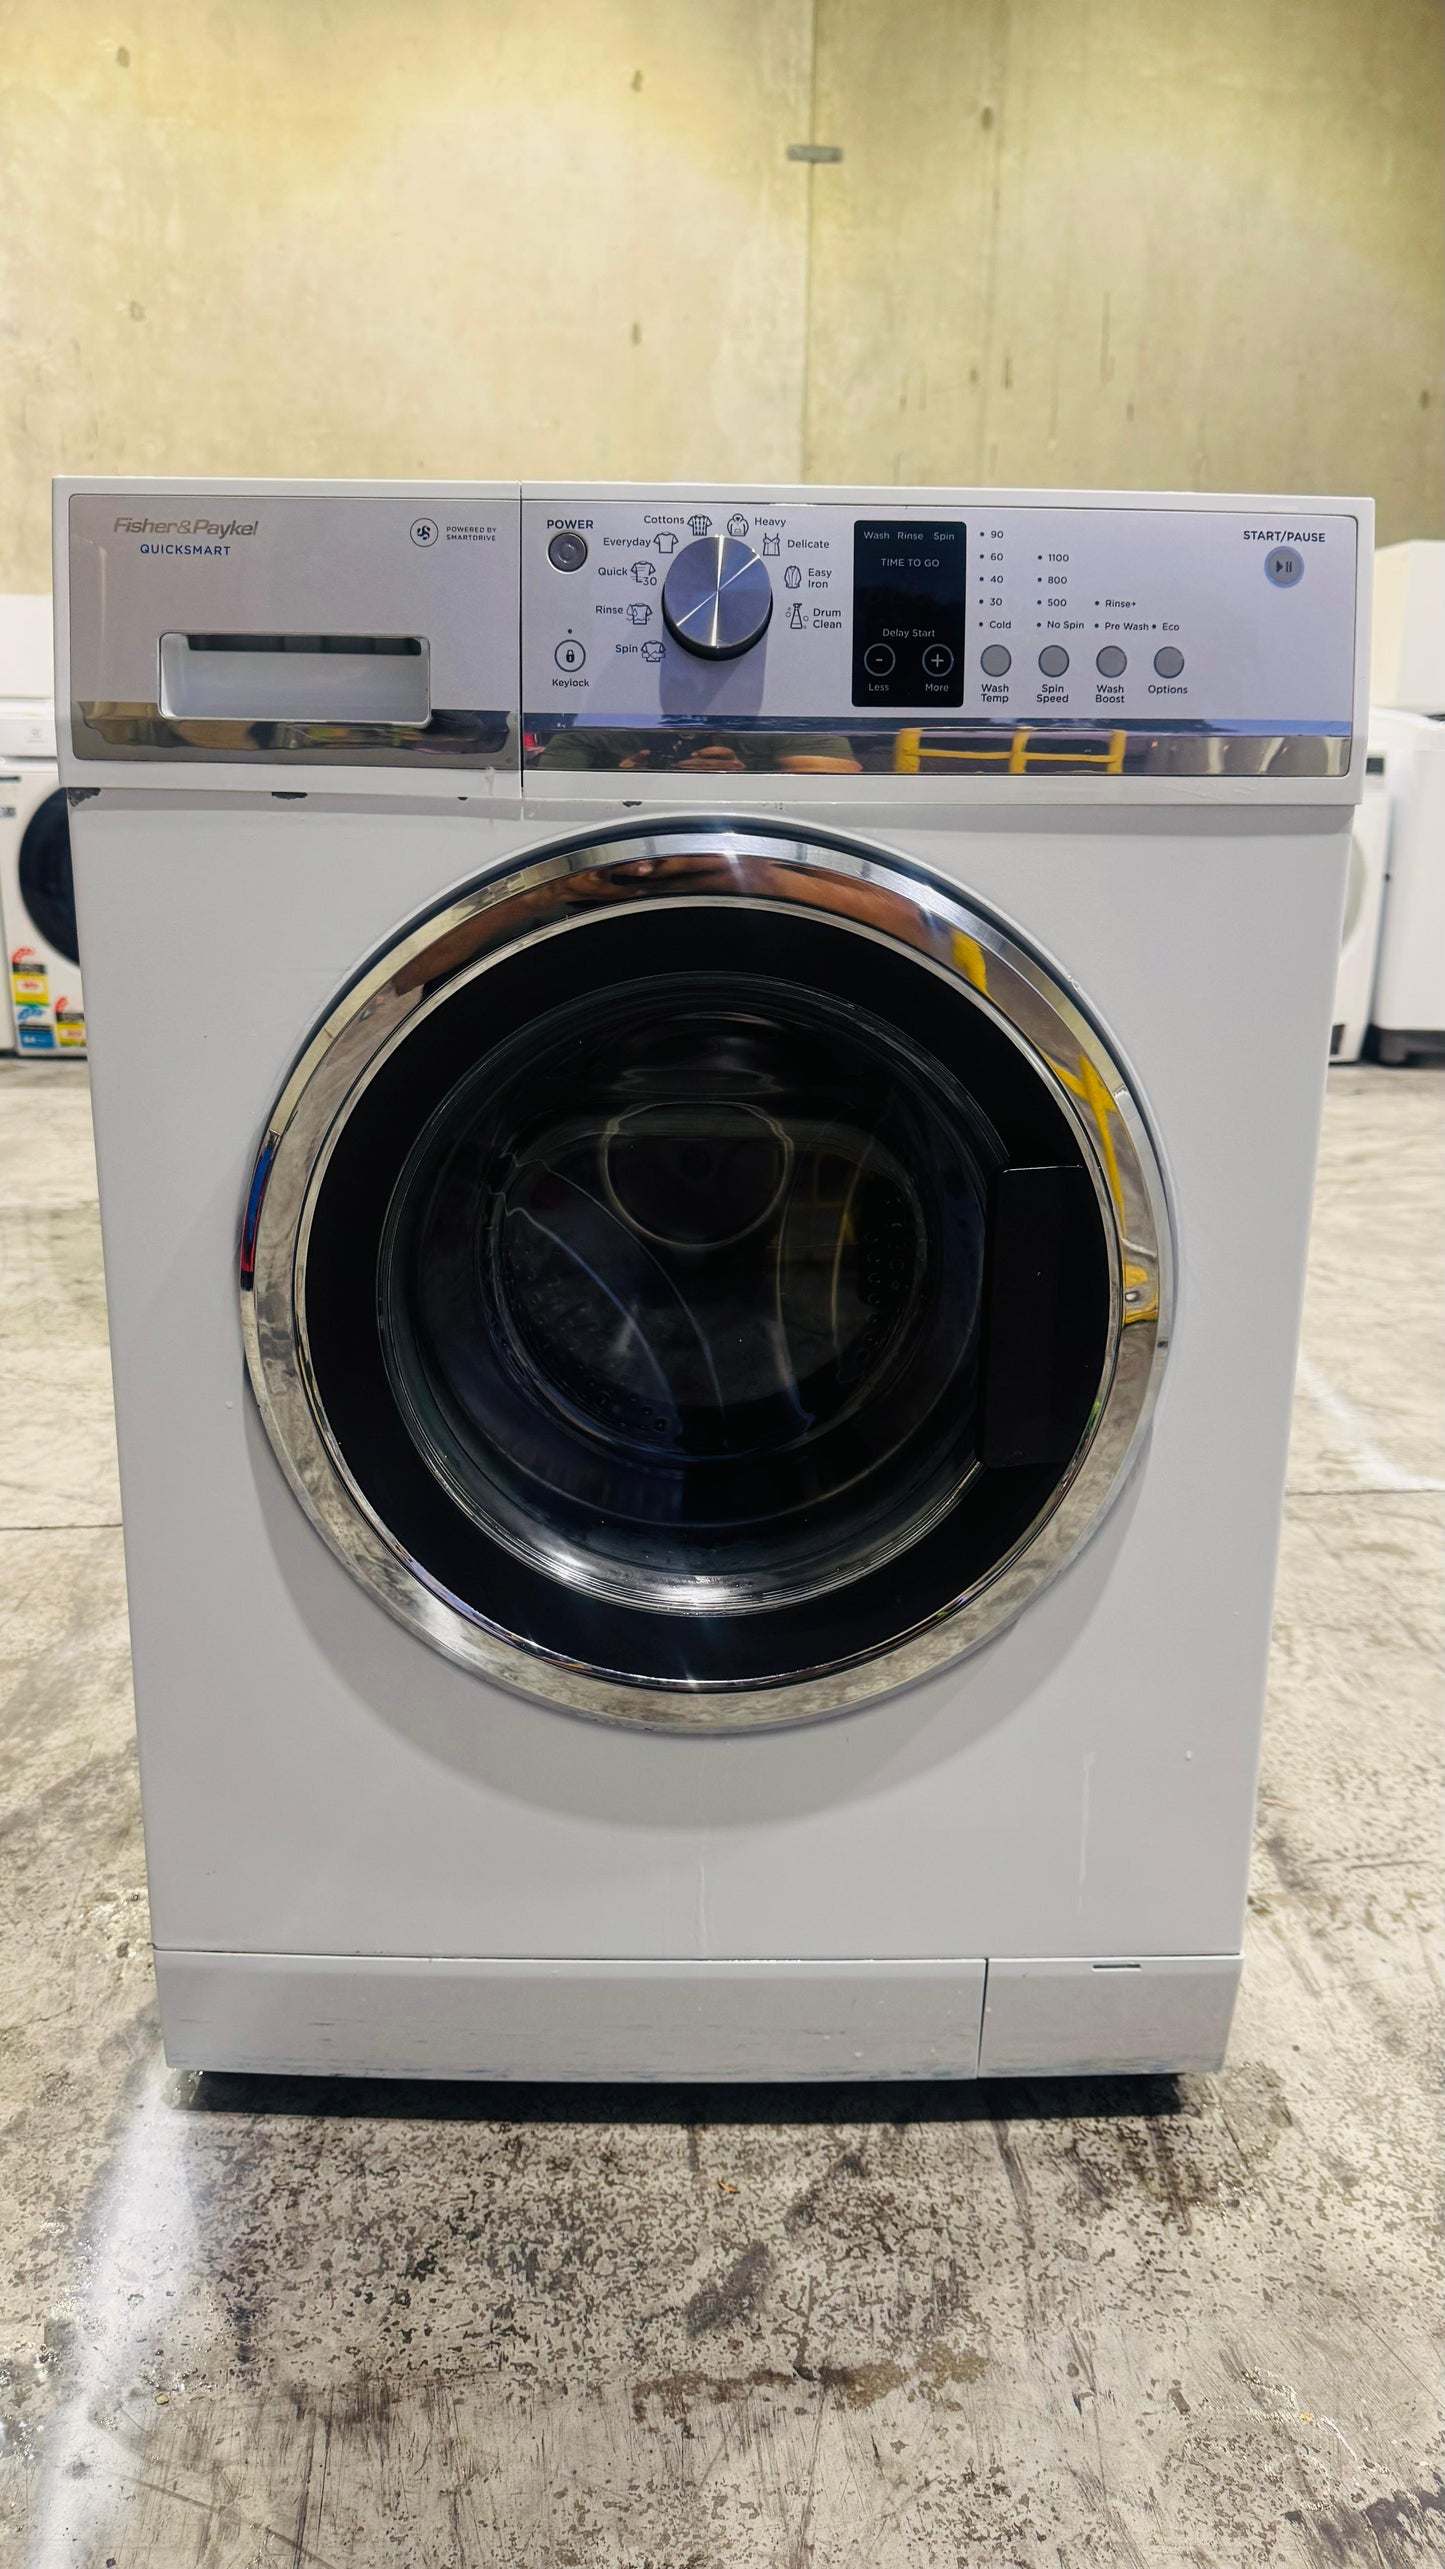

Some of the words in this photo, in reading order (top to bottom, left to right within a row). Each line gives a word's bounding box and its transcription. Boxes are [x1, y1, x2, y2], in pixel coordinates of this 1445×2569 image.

[546, 519, 594, 530] POWER
[643, 515, 685, 525] Cottons
[754, 517, 787, 528] Heavy
[113, 517, 259, 540] Fisher&Paykel
[446, 526, 485, 534] POWERED
[486, 526, 497, 534] BY
[446, 533, 496, 542] SMARTDRIVE
[863, 531, 890, 540] Wash
[897, 531, 924, 540] Rinse
[933, 531, 955, 541] Spin
[990, 530, 1004, 539] 90
[1243, 530, 1326, 543] START/PAUSE
[603, 537, 652, 548] Everyday
[787, 539, 830, 549] Delicate
[139, 543, 231, 556] QUICKSMART
[990, 552, 1004, 562] 60
[1048, 553, 1070, 563] 1100
[880, 558, 905, 567] TIME
[907, 558, 922, 568] TO
[923, 558, 940, 568] GO
[597, 566, 628, 576] Quick
[808, 567, 833, 579] Easy
[643, 576, 658, 586] 30
[808, 579, 829, 589] Iron
[990, 575, 1004, 584] 40
[1047, 575, 1068, 585] 800
[989, 597, 1003, 607] 30
[1047, 598, 1067, 607] 500
[1105, 599, 1137, 608] Rinse+
[595, 605, 624, 615] Rinse
[813, 607, 842, 617] Drum
[812, 619, 842, 629] Clean
[989, 620, 1012, 629] Cold
[1047, 620, 1061, 629] No
[1063, 620, 1085, 630] Spin
[1104, 621, 1121, 631] Pre
[1123, 622, 1149, 631] Wash
[1162, 622, 1180, 631] Eco
[882, 628, 910, 638] Delay
[912, 628, 935, 638] Start
[615, 644, 639, 654] Spin
[552, 678, 590, 688] Keylock
[868, 683, 890, 692] Less
[925, 683, 949, 692] More
[981, 683, 1010, 693] Wash
[1040, 683, 1065, 696] Spin
[1095, 684, 1125, 694] Wash
[1147, 684, 1188, 695] Options
[980, 693, 1009, 704] Temp
[1036, 693, 1069, 704] Speed
[1095, 693, 1125, 704] Boost
